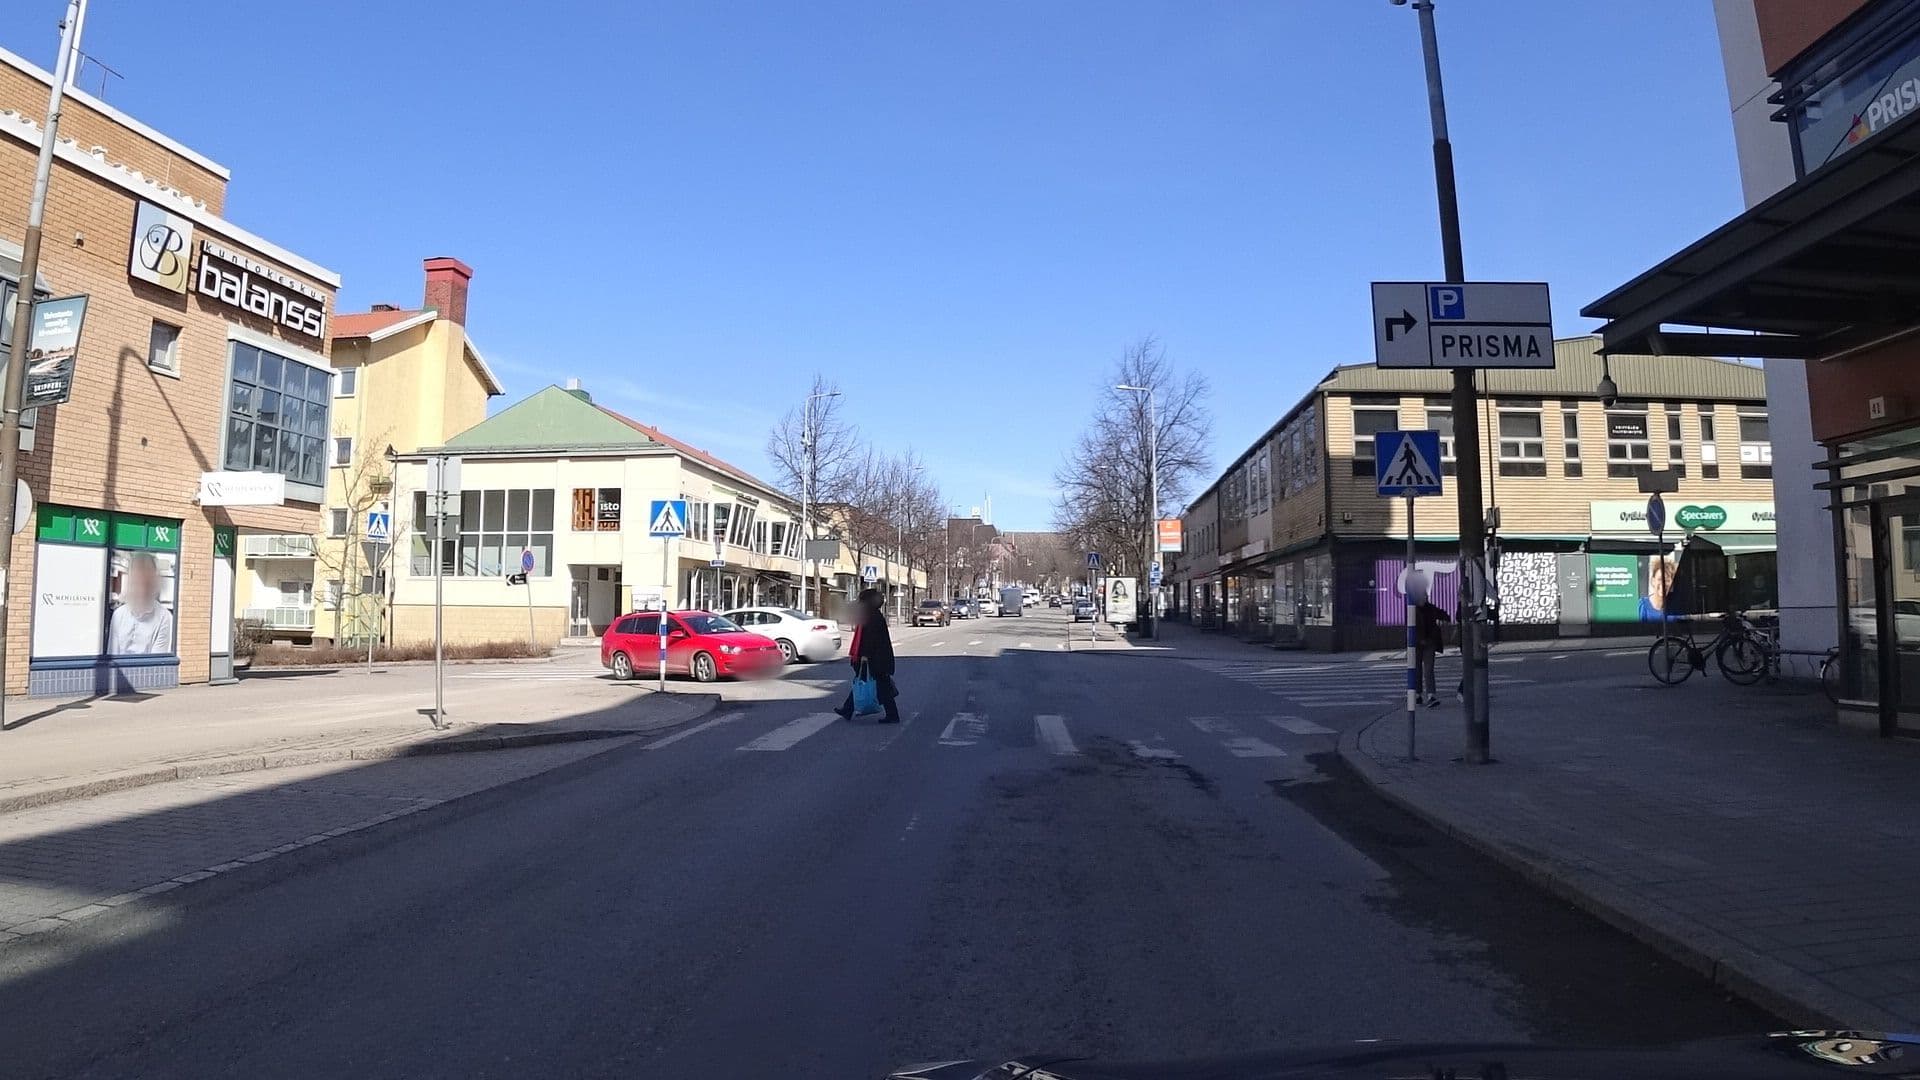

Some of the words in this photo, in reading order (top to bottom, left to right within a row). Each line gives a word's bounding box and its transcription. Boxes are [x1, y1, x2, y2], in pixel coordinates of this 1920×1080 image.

[205, 241, 326, 300] kuntokeskus
[199, 255, 327, 339] balanssi
[1437, 289, 1459, 317] P
[1441, 334, 1541, 358] PRISMA
[1681, 510, 1724, 521] Specsavers
